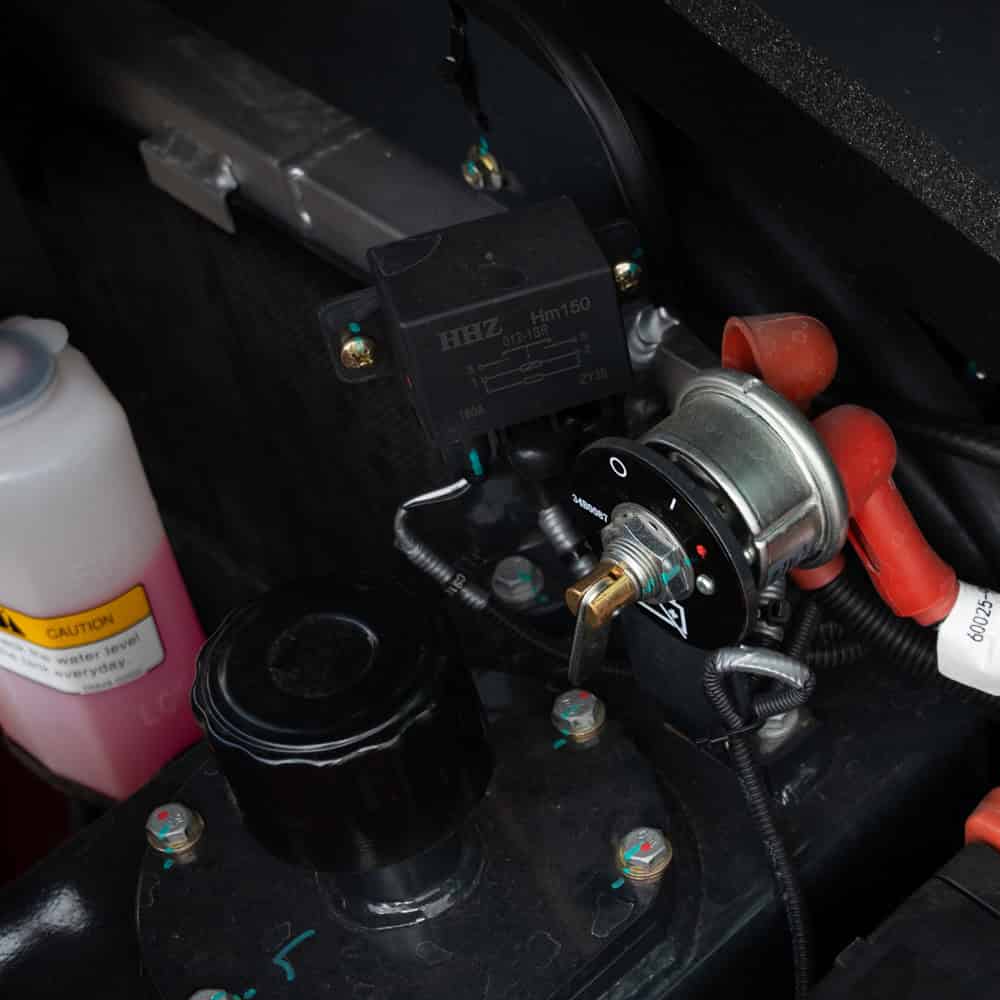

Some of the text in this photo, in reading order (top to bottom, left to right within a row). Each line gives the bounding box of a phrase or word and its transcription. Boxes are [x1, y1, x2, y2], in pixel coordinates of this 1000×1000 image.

[439, 317, 503, 351] HHZ
[46, 613, 115, 640] CAUTION
[103, 632, 141, 656] level
